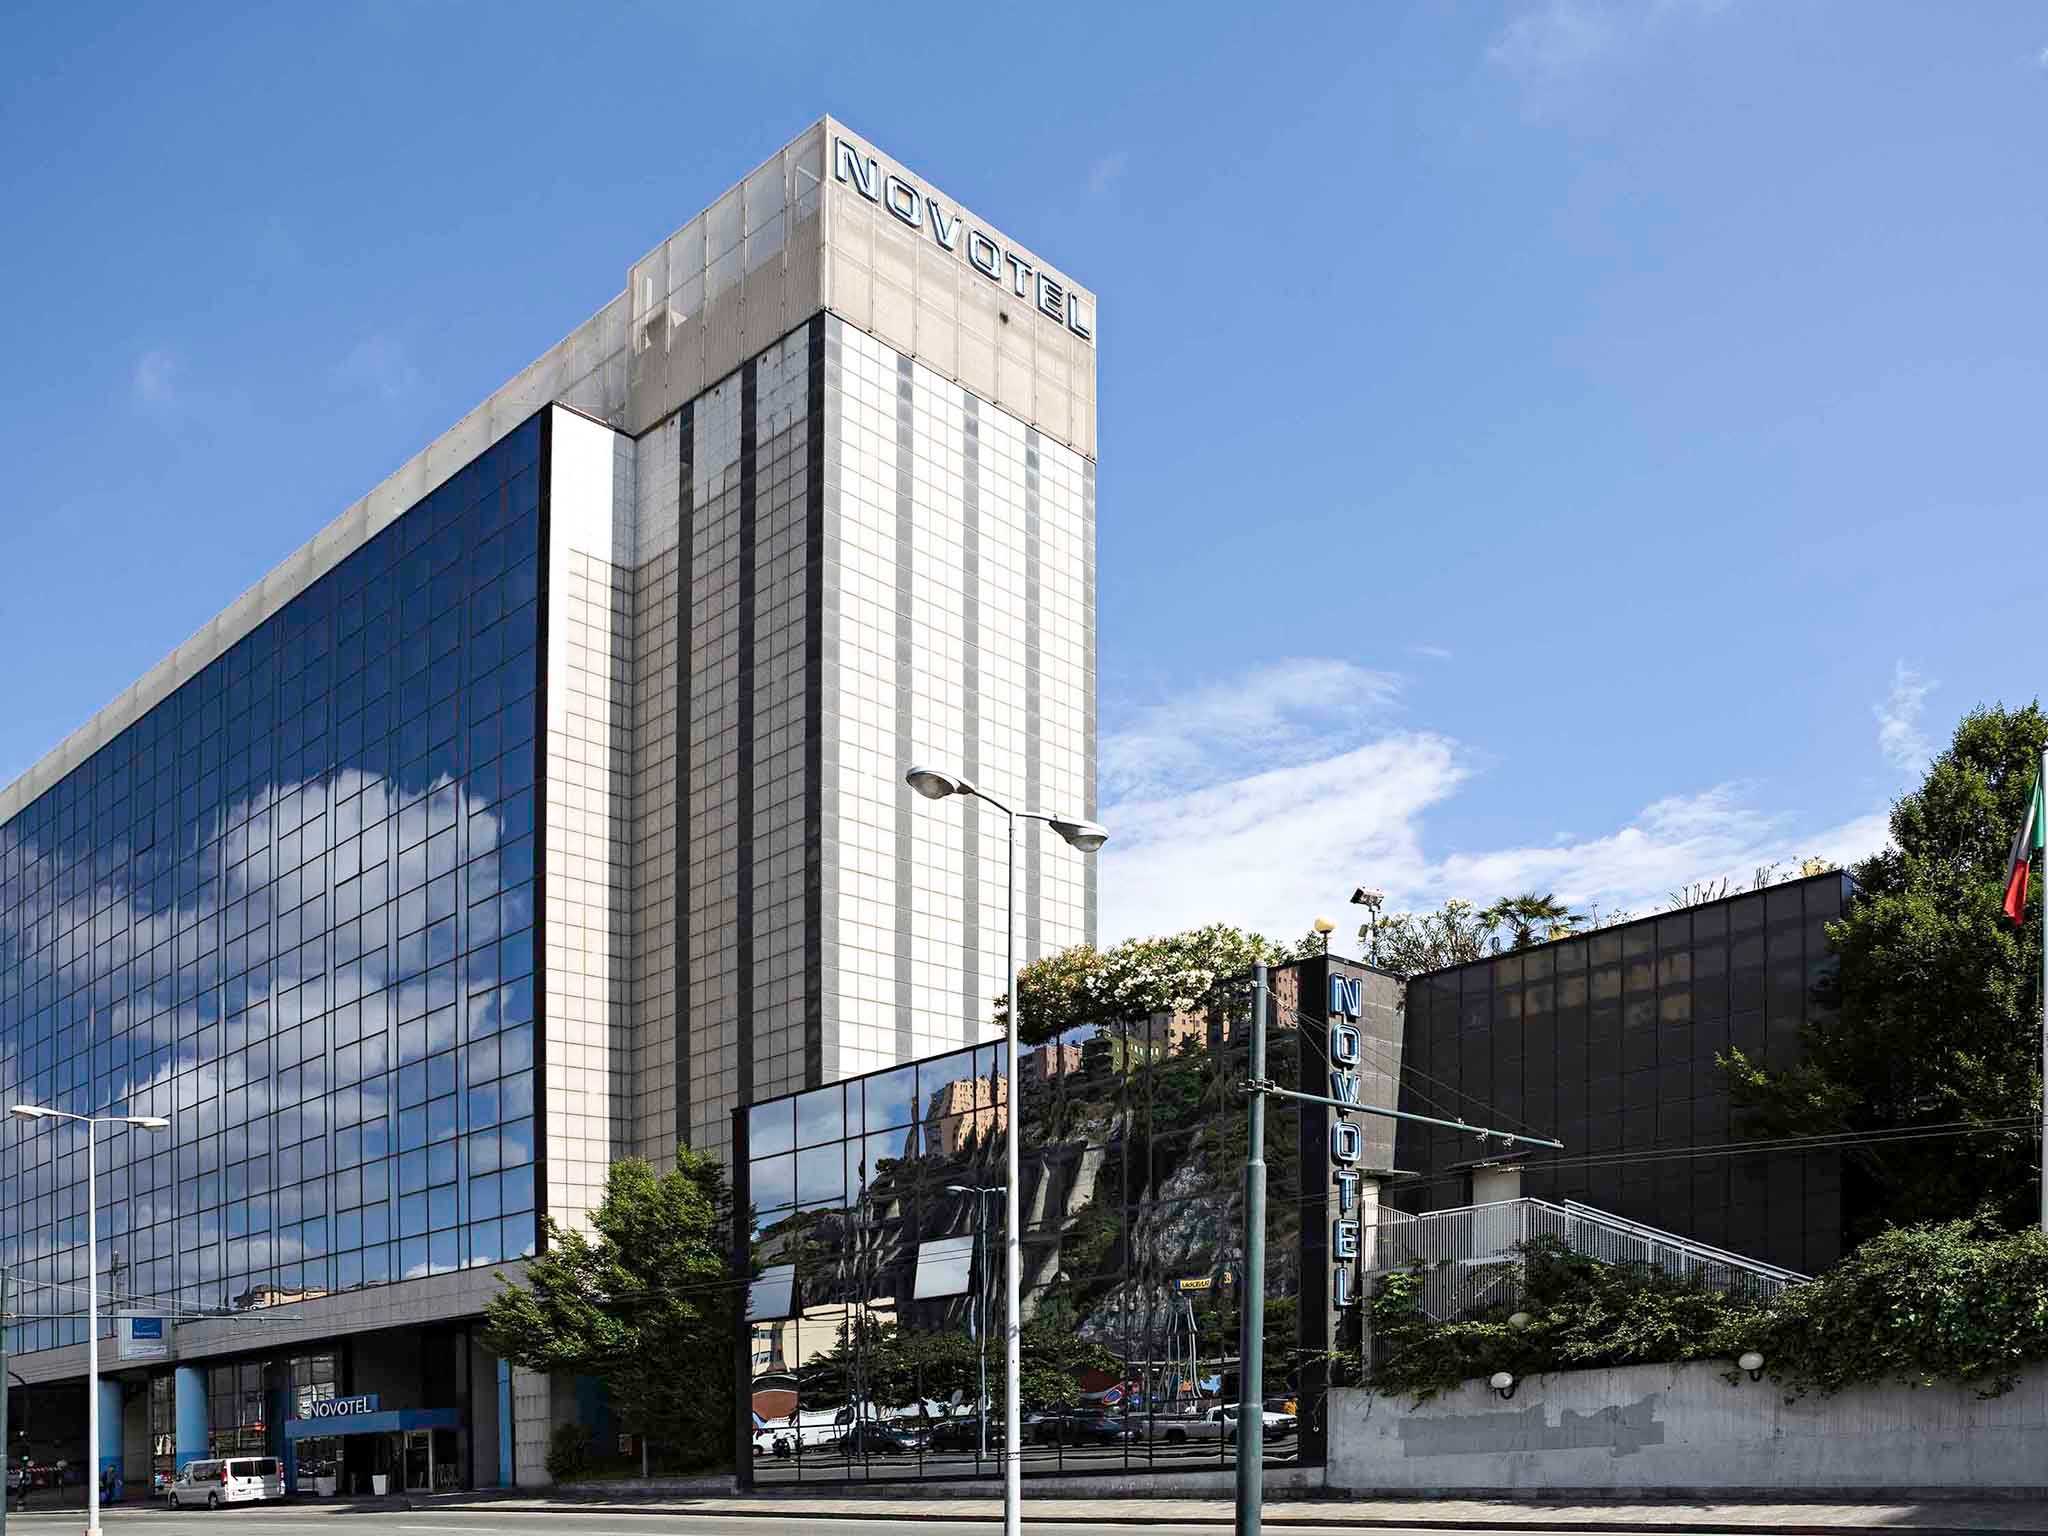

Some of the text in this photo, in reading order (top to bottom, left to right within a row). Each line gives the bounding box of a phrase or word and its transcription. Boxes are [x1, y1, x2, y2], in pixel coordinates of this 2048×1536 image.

[834, 135, 1091, 341] NOVOTEL
[1329, 972, 1362, 1309] NOVOTEL
[309, 1396, 373, 1417] NOVOTEL
